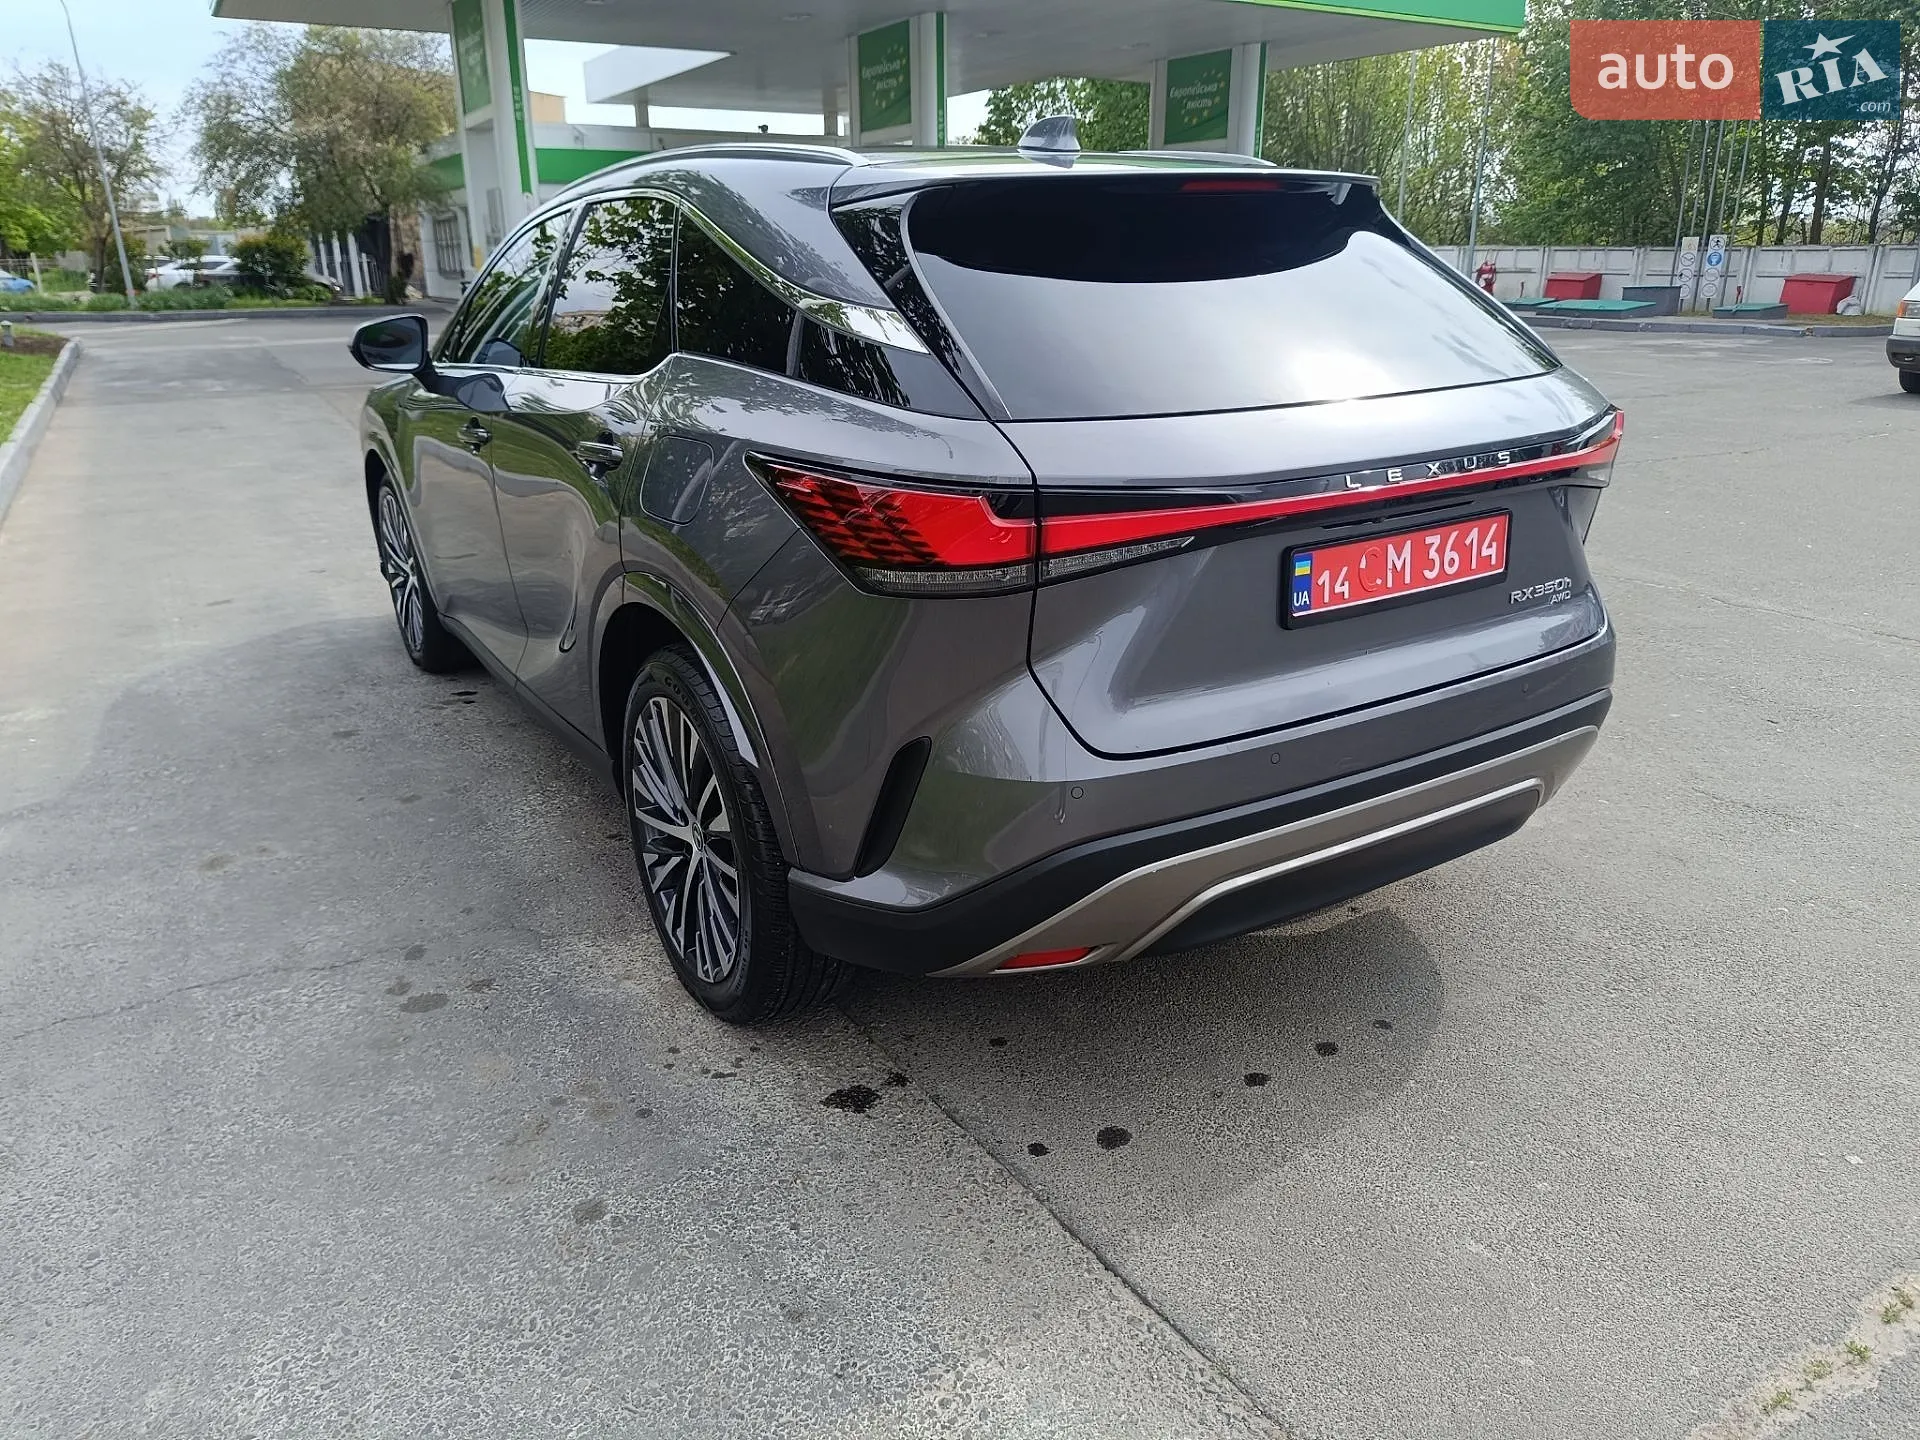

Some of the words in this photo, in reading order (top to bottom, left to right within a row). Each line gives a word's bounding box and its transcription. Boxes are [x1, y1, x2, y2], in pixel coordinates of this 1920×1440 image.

[1345, 450, 1511, 489] LEXUS
[1317, 566, 1349, 604] 14
[1422, 522, 1499, 580] 3614
[1293, 590, 1310, 607] UA
[1549, 590, 1571, 605] AWD
